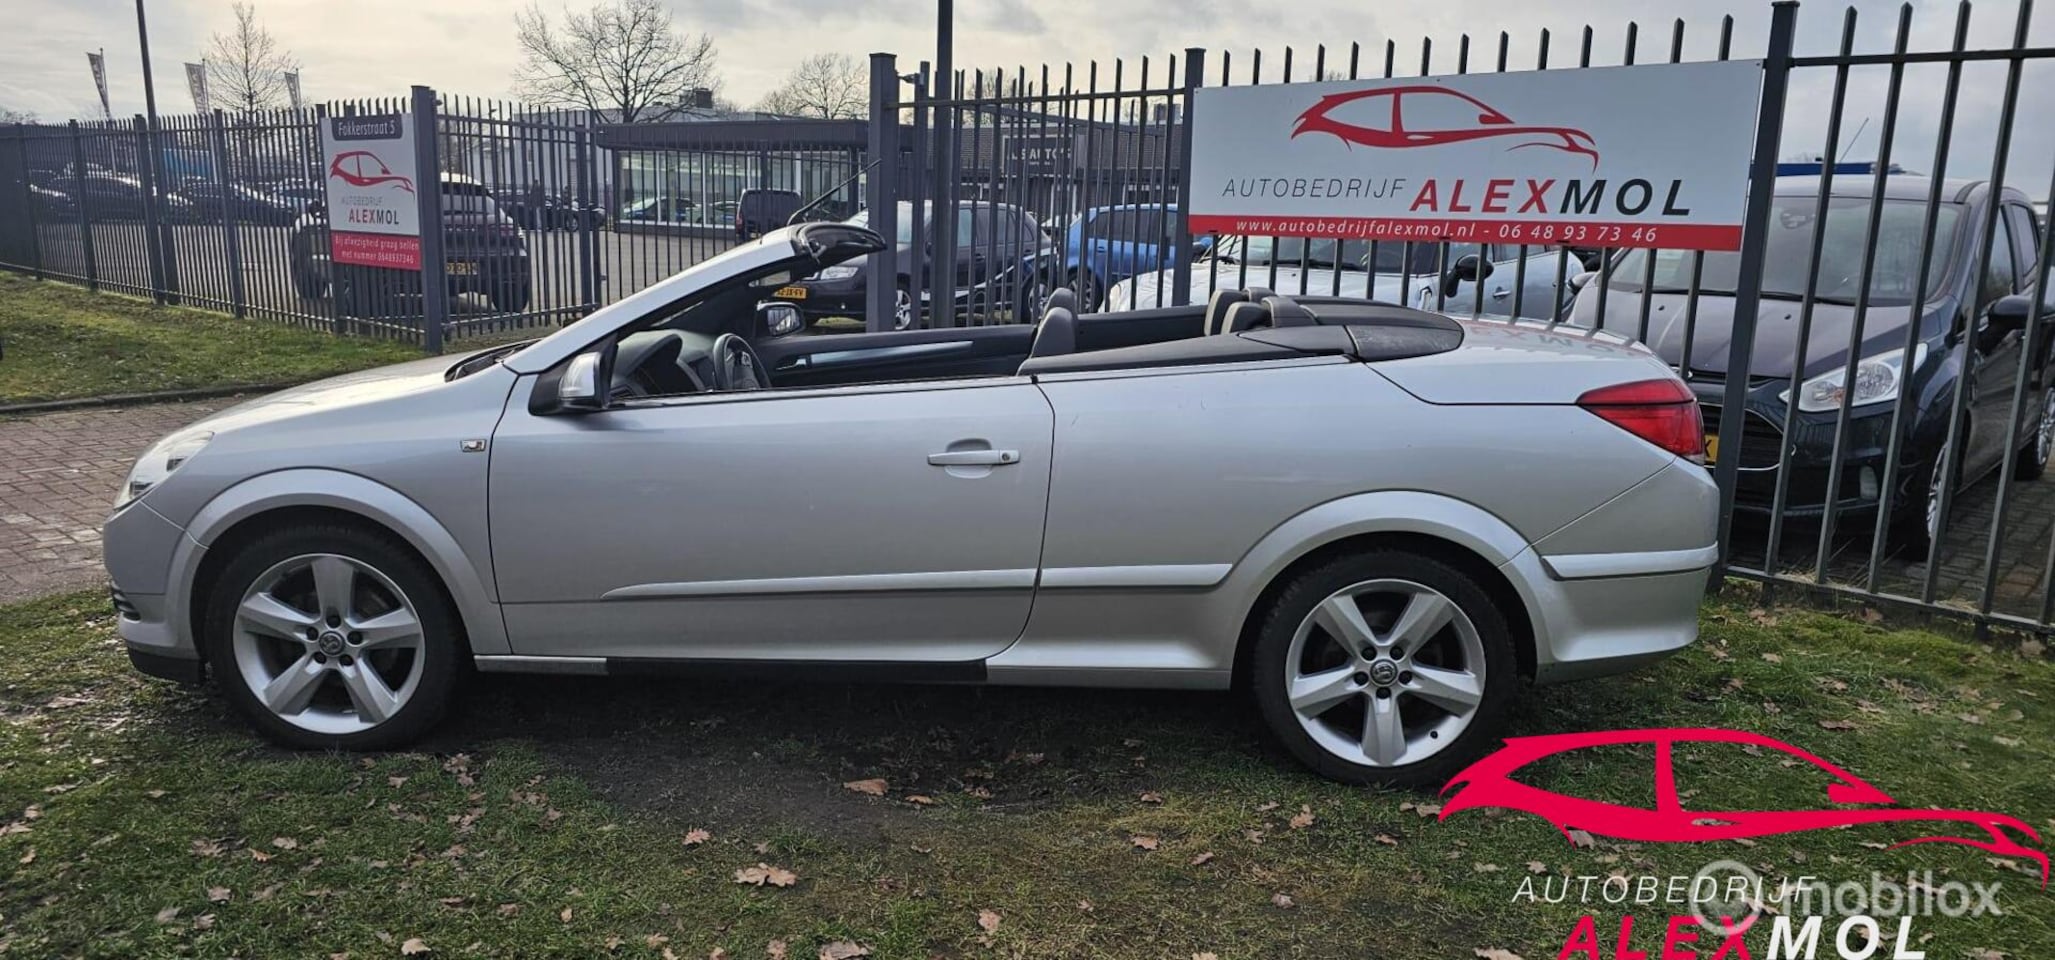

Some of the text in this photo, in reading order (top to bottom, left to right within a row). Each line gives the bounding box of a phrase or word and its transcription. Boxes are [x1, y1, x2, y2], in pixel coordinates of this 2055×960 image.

[338, 120, 396, 137] Fokkerstraat 5
[1222, 178, 1690, 216] AUTOBEDRIJF ALEXMOL
[348, 208, 400, 225] ALEXMOL
[1236, 219, 1476, 238] www.autobedrijfalexmol.nl
[1499, 223, 1521, 239] 06
[1530, 224, 1554, 240] 48
[1563, 225, 1587, 240] 93
[1597, 226, 1621, 242] 73
[1632, 227, 1657, 242] 46
[380, 240, 397, 251] graag
[399, 239, 419, 251] bellen
[341, 250, 352, 258] met
[353, 251, 377, 260] nummer
